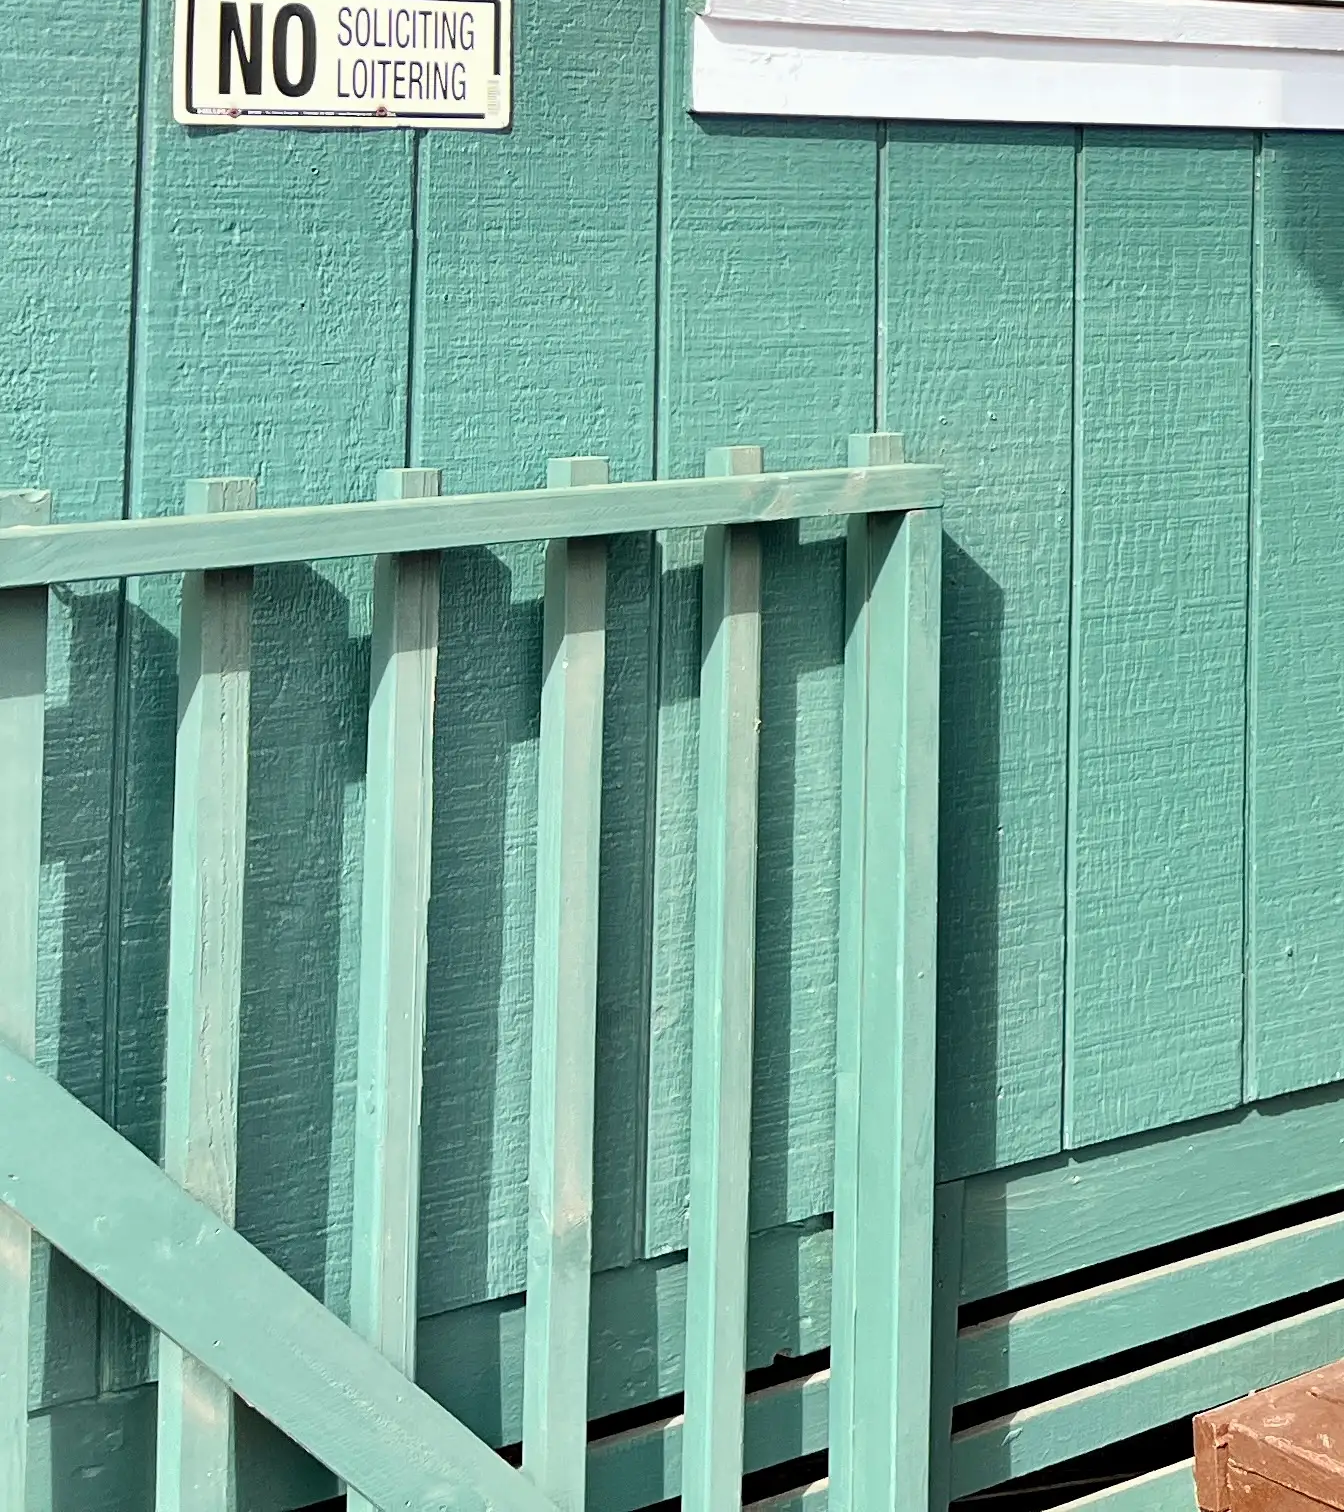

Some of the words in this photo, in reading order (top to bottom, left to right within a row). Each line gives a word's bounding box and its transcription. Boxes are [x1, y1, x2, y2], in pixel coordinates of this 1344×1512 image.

[218, 1, 317, 98] NO
[337, 6, 475, 51] SOLICITING
[337, 57, 467, 101] LOITERING
